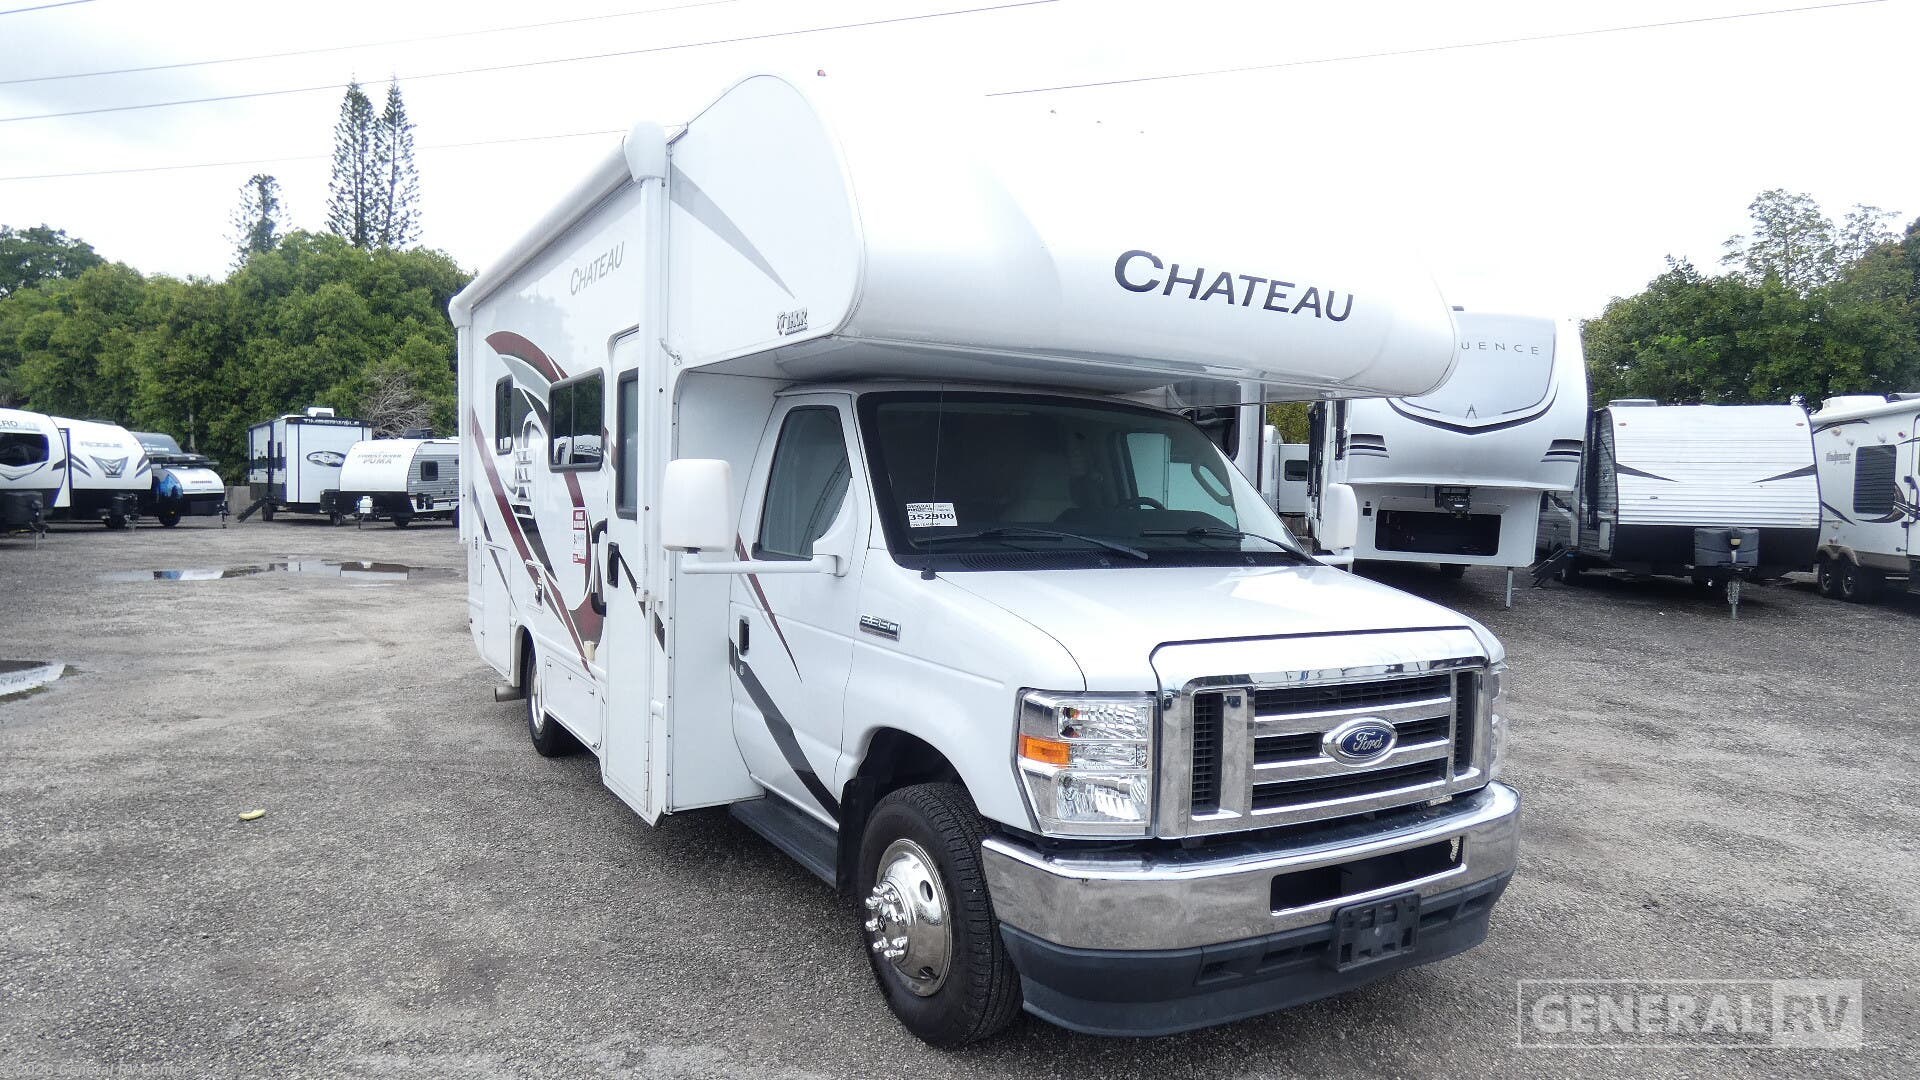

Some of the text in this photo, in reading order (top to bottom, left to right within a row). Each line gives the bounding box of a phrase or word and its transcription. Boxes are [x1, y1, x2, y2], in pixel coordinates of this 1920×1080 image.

[570, 241, 624, 295] CHATEAU
[1114, 249, 1353, 322] CHATEAU
[1353, 731, 1384, 752] Ford
